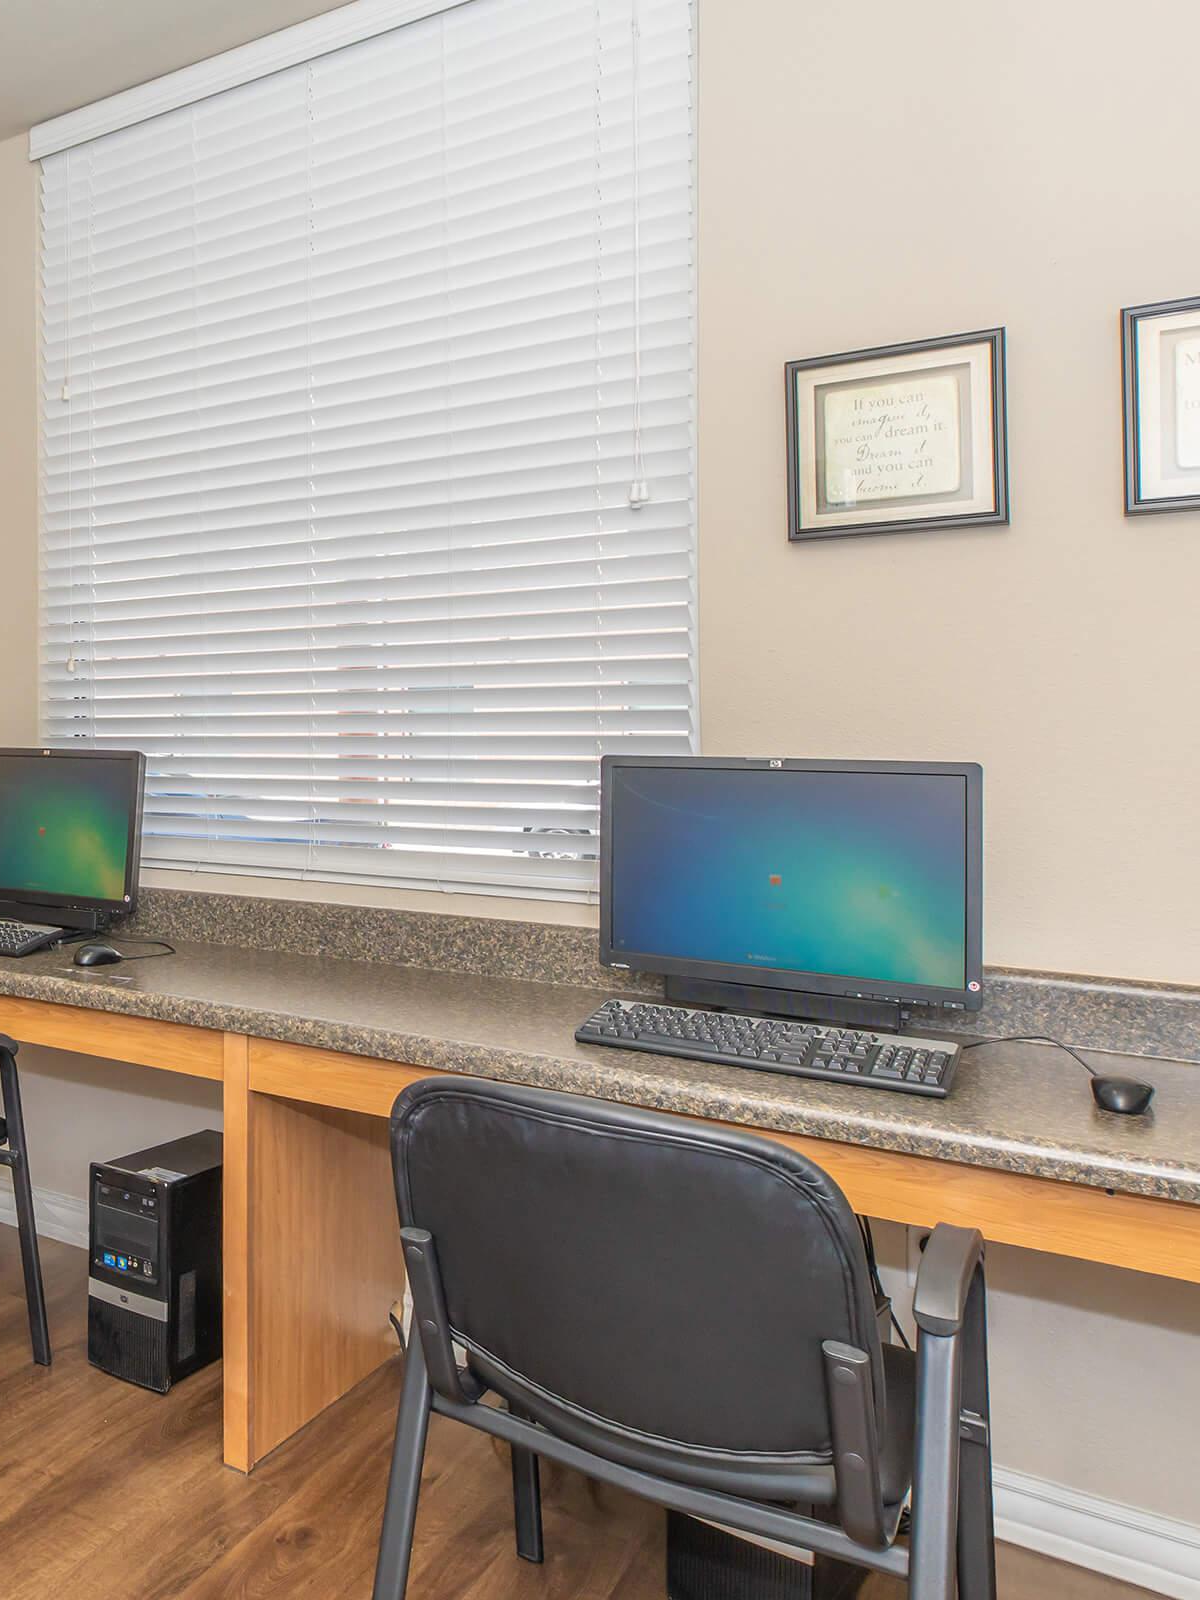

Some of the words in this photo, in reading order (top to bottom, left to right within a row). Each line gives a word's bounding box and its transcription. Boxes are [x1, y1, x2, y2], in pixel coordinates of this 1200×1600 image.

[869, 396, 894, 410] you
[898, 391, 924, 405] can
[833, 435, 853, 447] you
[855, 433, 873, 444] can
[884, 423, 929, 439] dream
[855, 441, 902, 462] Dream
[850, 464, 872, 477] and
[877, 462, 903, 476] you
[907, 457, 934, 470] can
